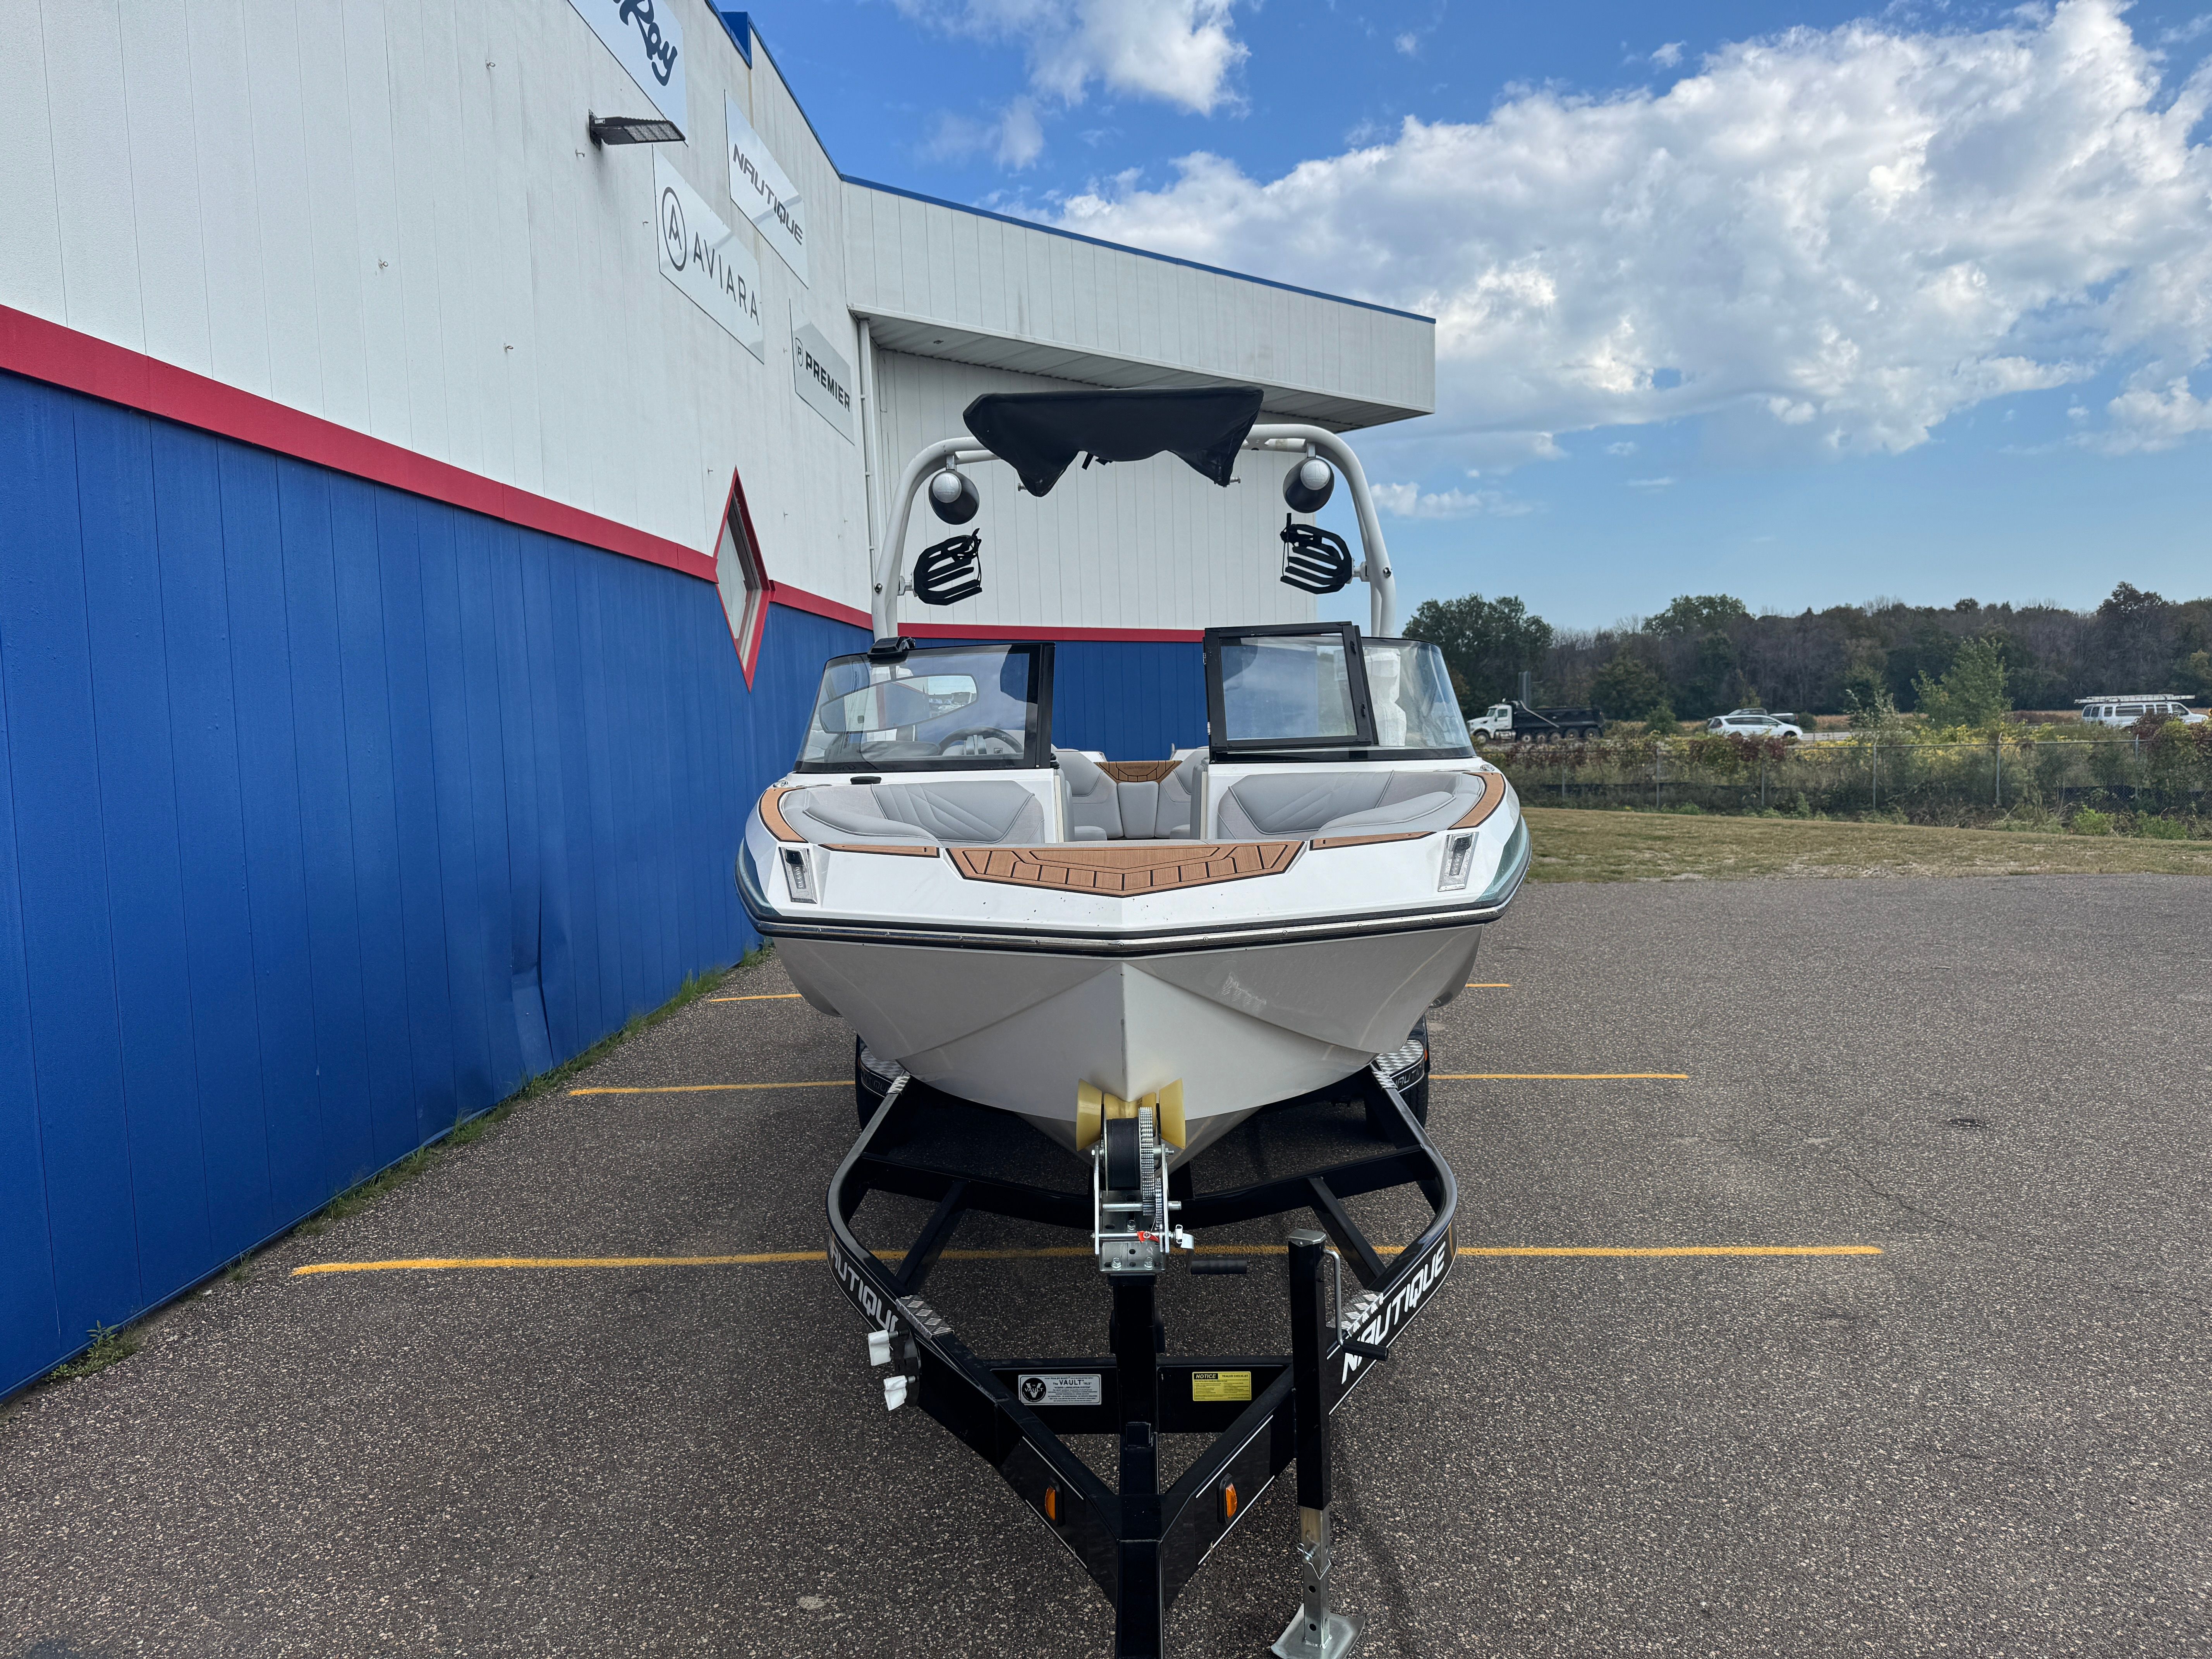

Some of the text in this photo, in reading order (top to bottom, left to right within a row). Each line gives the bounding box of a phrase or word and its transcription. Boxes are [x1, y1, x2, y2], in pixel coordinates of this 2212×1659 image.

[733, 143, 803, 246] NAUTIQUE
[693, 231, 759, 326] AVIARA
[805, 350, 850, 412] PREMIER
